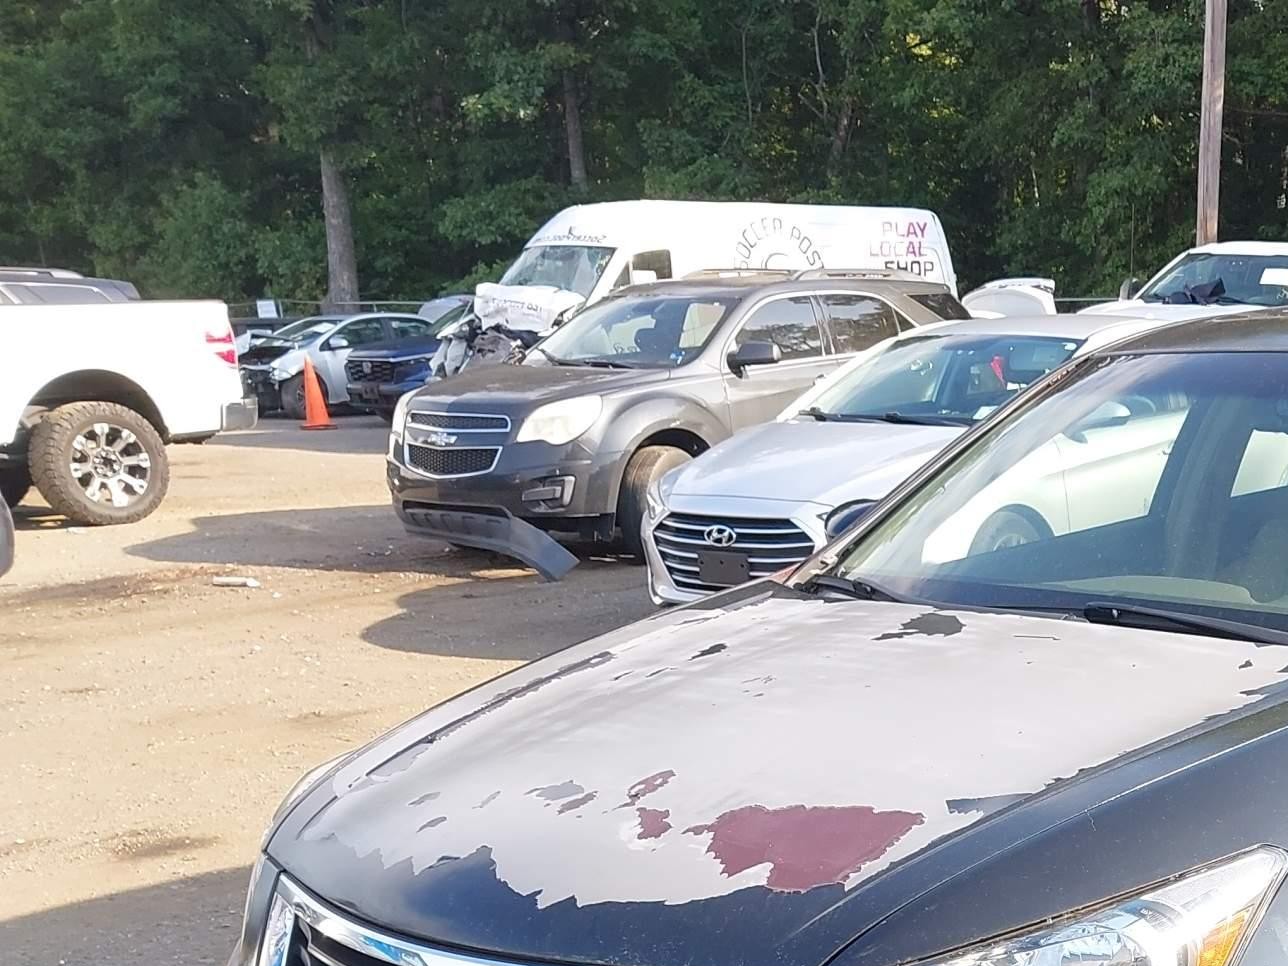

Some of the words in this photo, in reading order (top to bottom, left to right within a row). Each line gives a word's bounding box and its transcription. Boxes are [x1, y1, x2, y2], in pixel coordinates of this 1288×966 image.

[882, 221, 928, 238] PLAY
[790, 225, 824, 269] POS
[869, 240, 928, 257] LOCAL
